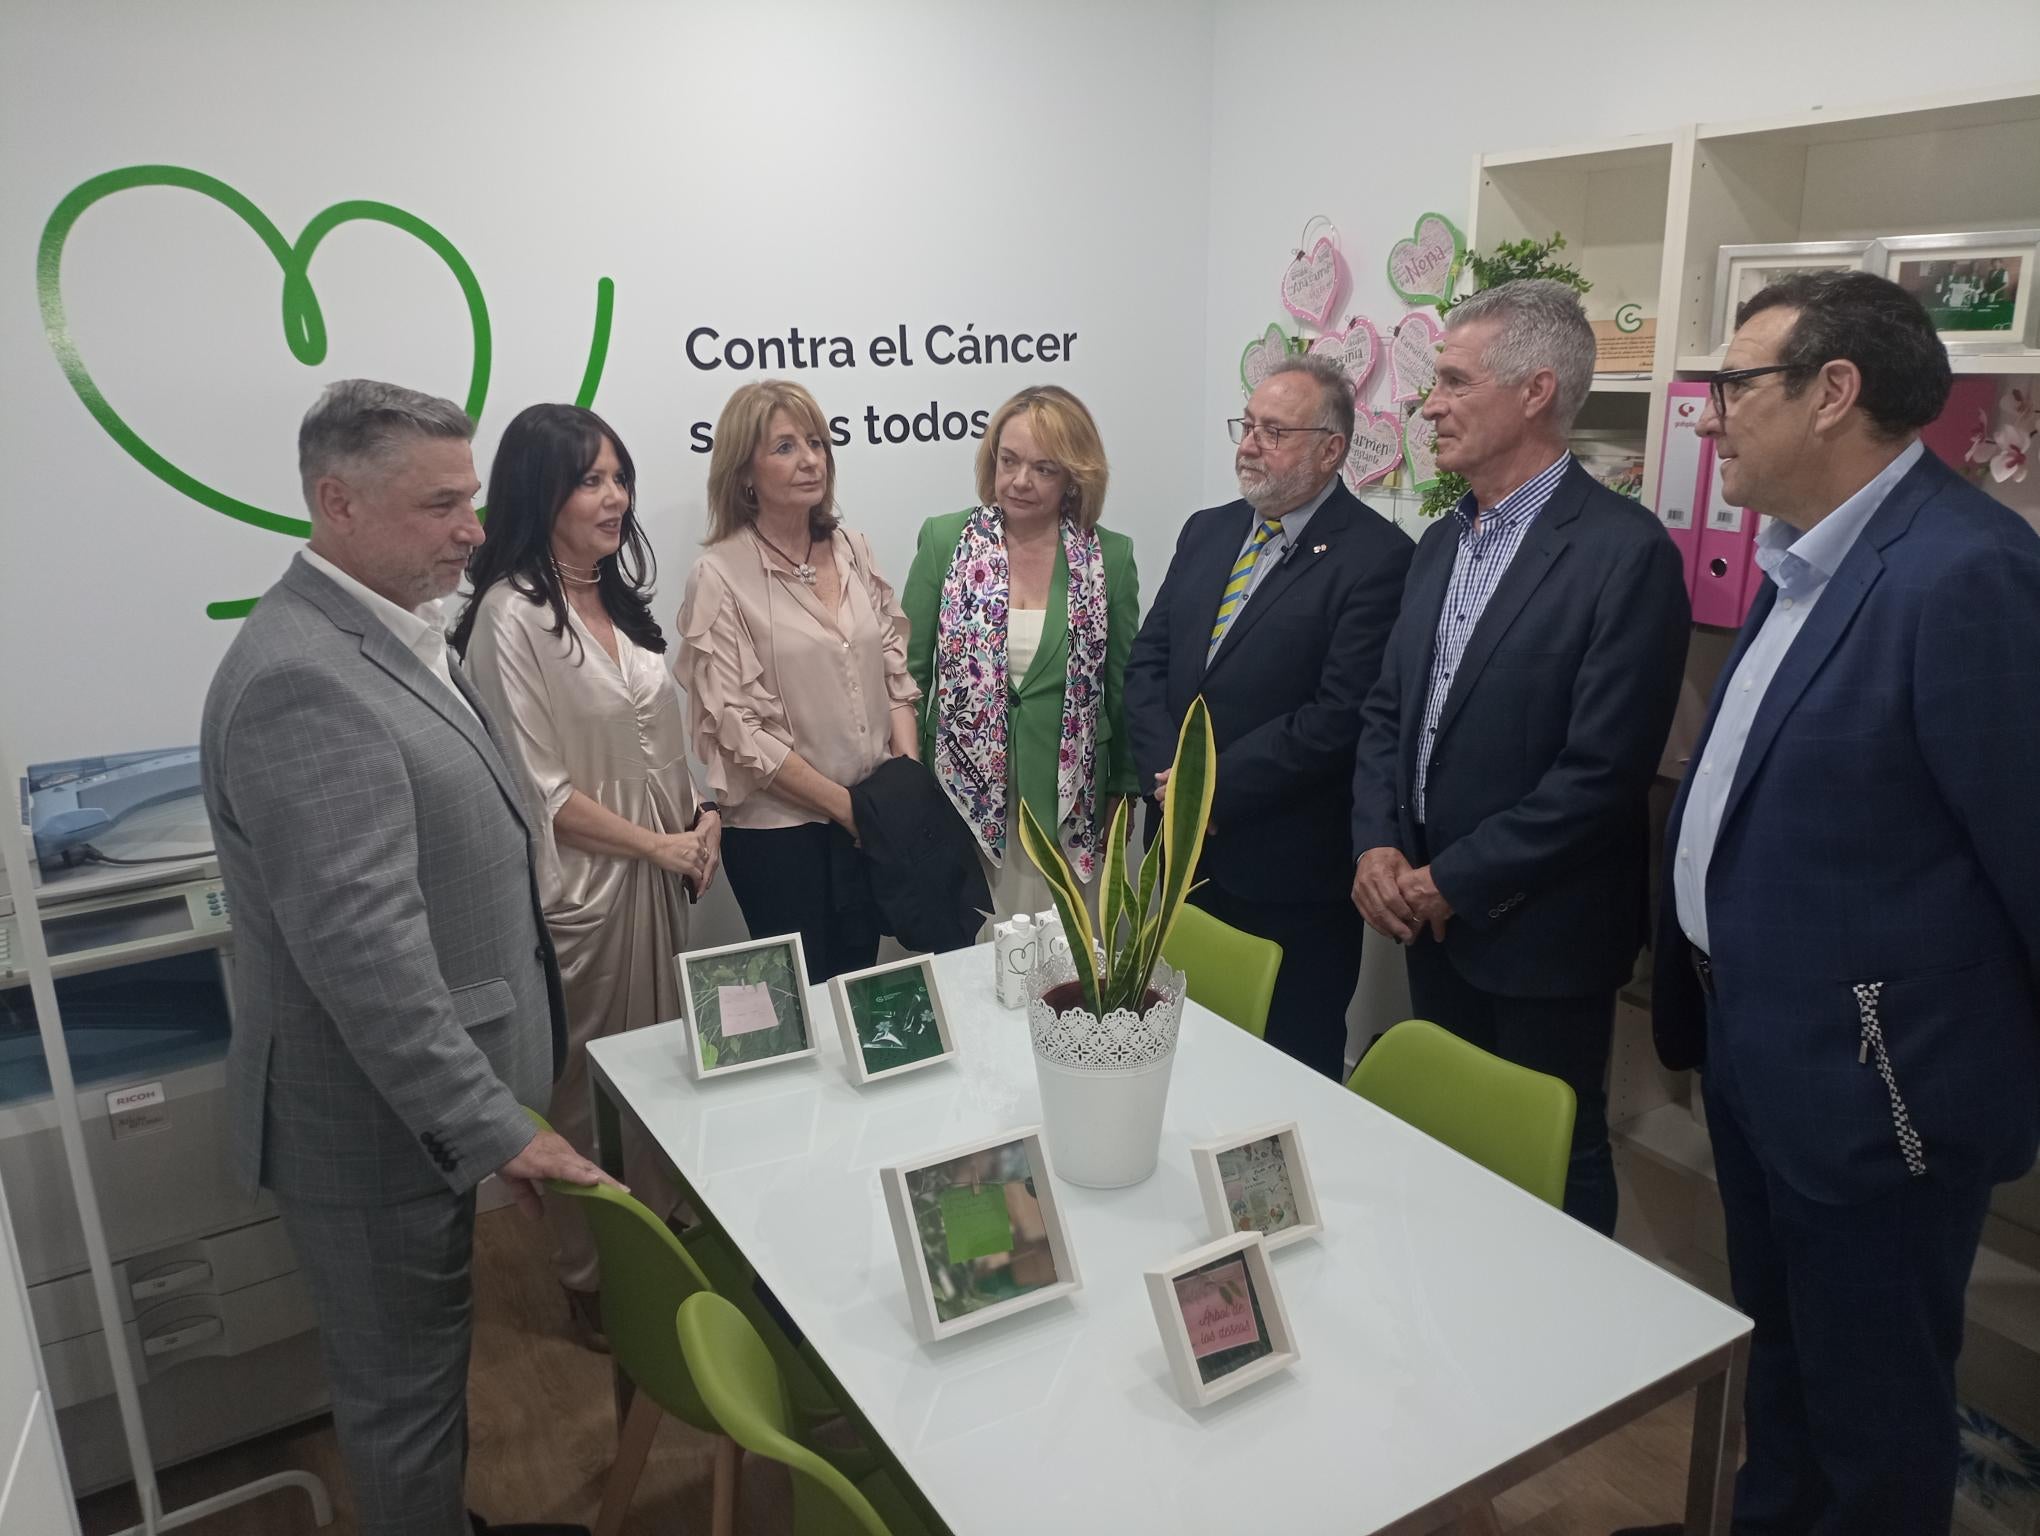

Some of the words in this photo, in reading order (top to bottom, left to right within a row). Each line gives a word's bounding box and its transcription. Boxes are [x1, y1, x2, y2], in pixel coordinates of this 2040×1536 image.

[685, 327, 856, 371] Contra
[869, 324, 913, 367] el
[924, 322, 1078, 365] Cáncer
[863, 401, 990, 445] todos
[1352, 432, 1389, 456] armen
[948, 740, 967, 765] BIMBA
[970, 768, 984, 788] LOLA
[116, 1091, 156, 1105] RICOH
